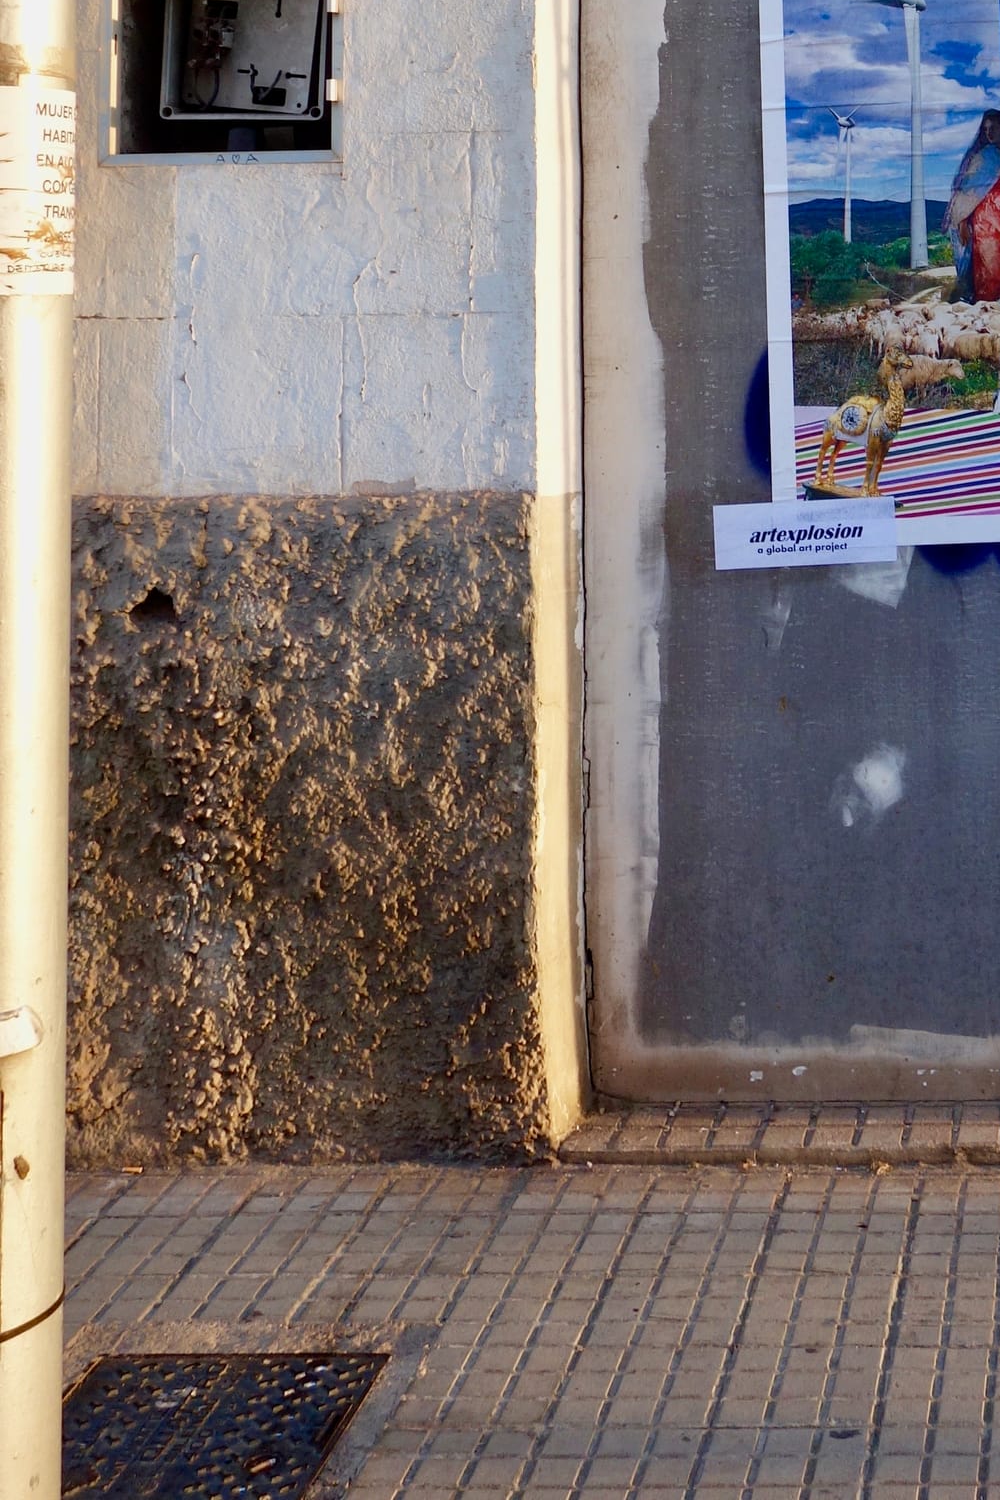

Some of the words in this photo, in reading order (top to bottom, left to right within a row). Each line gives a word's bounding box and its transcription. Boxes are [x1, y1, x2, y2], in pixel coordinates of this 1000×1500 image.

[749, 523, 864, 544] artexplosion
[766, 543, 796, 556] global
[799, 544, 813, 552] art
[815, 542, 848, 553] project
